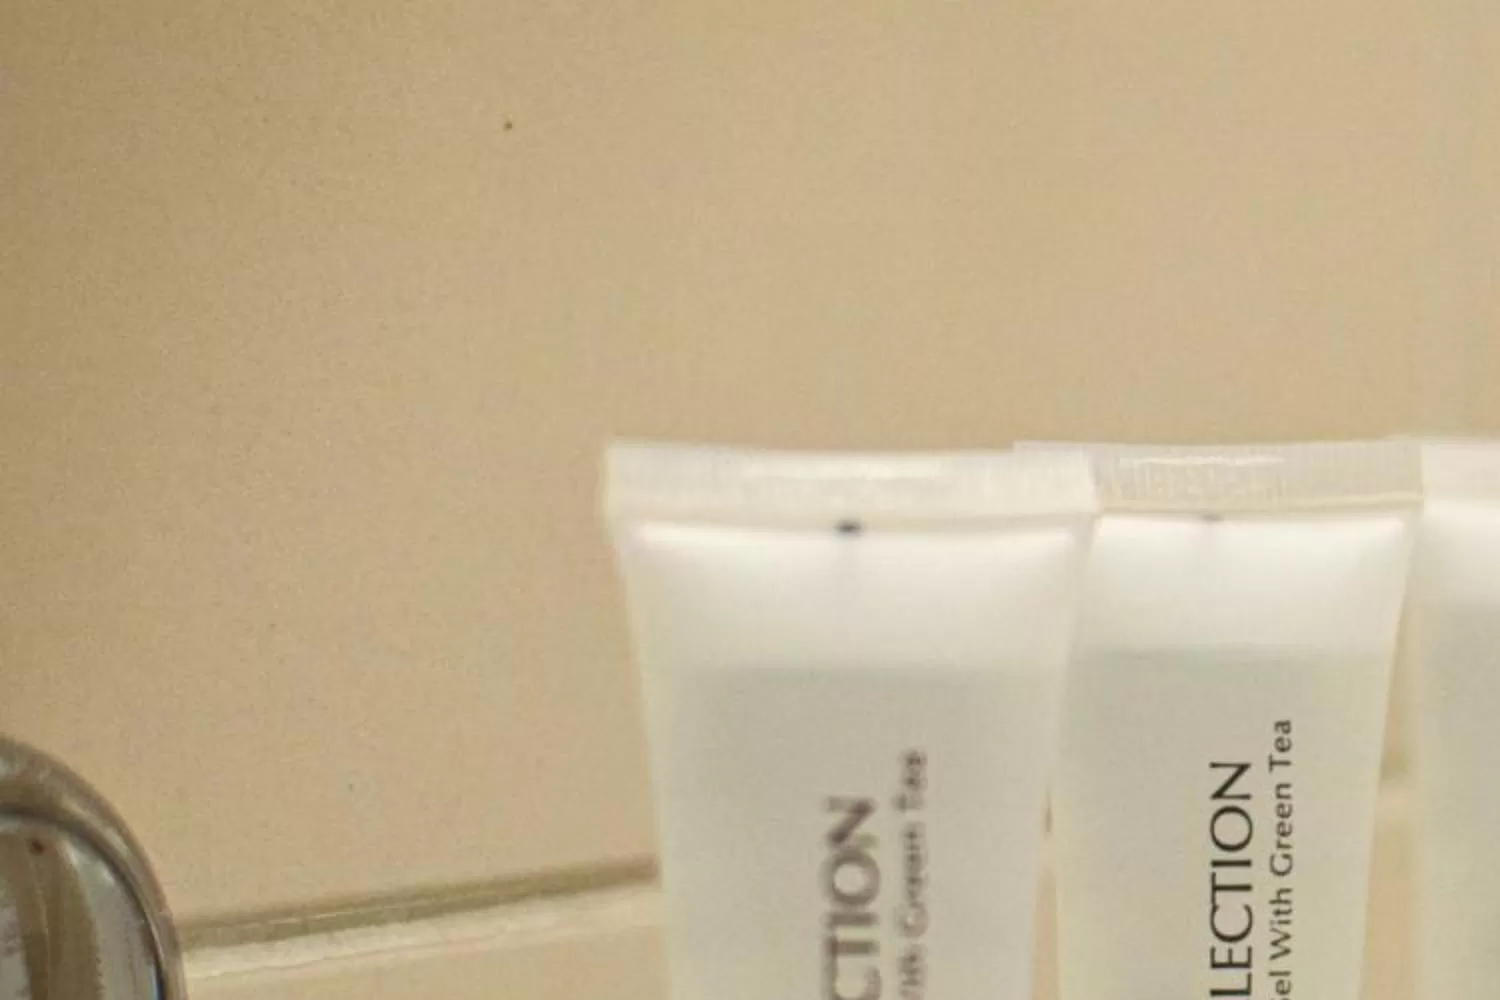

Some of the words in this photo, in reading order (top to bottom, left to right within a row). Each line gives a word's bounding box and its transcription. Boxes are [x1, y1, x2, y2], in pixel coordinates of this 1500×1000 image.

[891, 748, 928, 813] Tea
[1268, 719, 1293, 773] Tea
[1269, 782, 1294, 877] Green
[893, 824, 928, 939] Green
[1268, 888, 1294, 960] With
